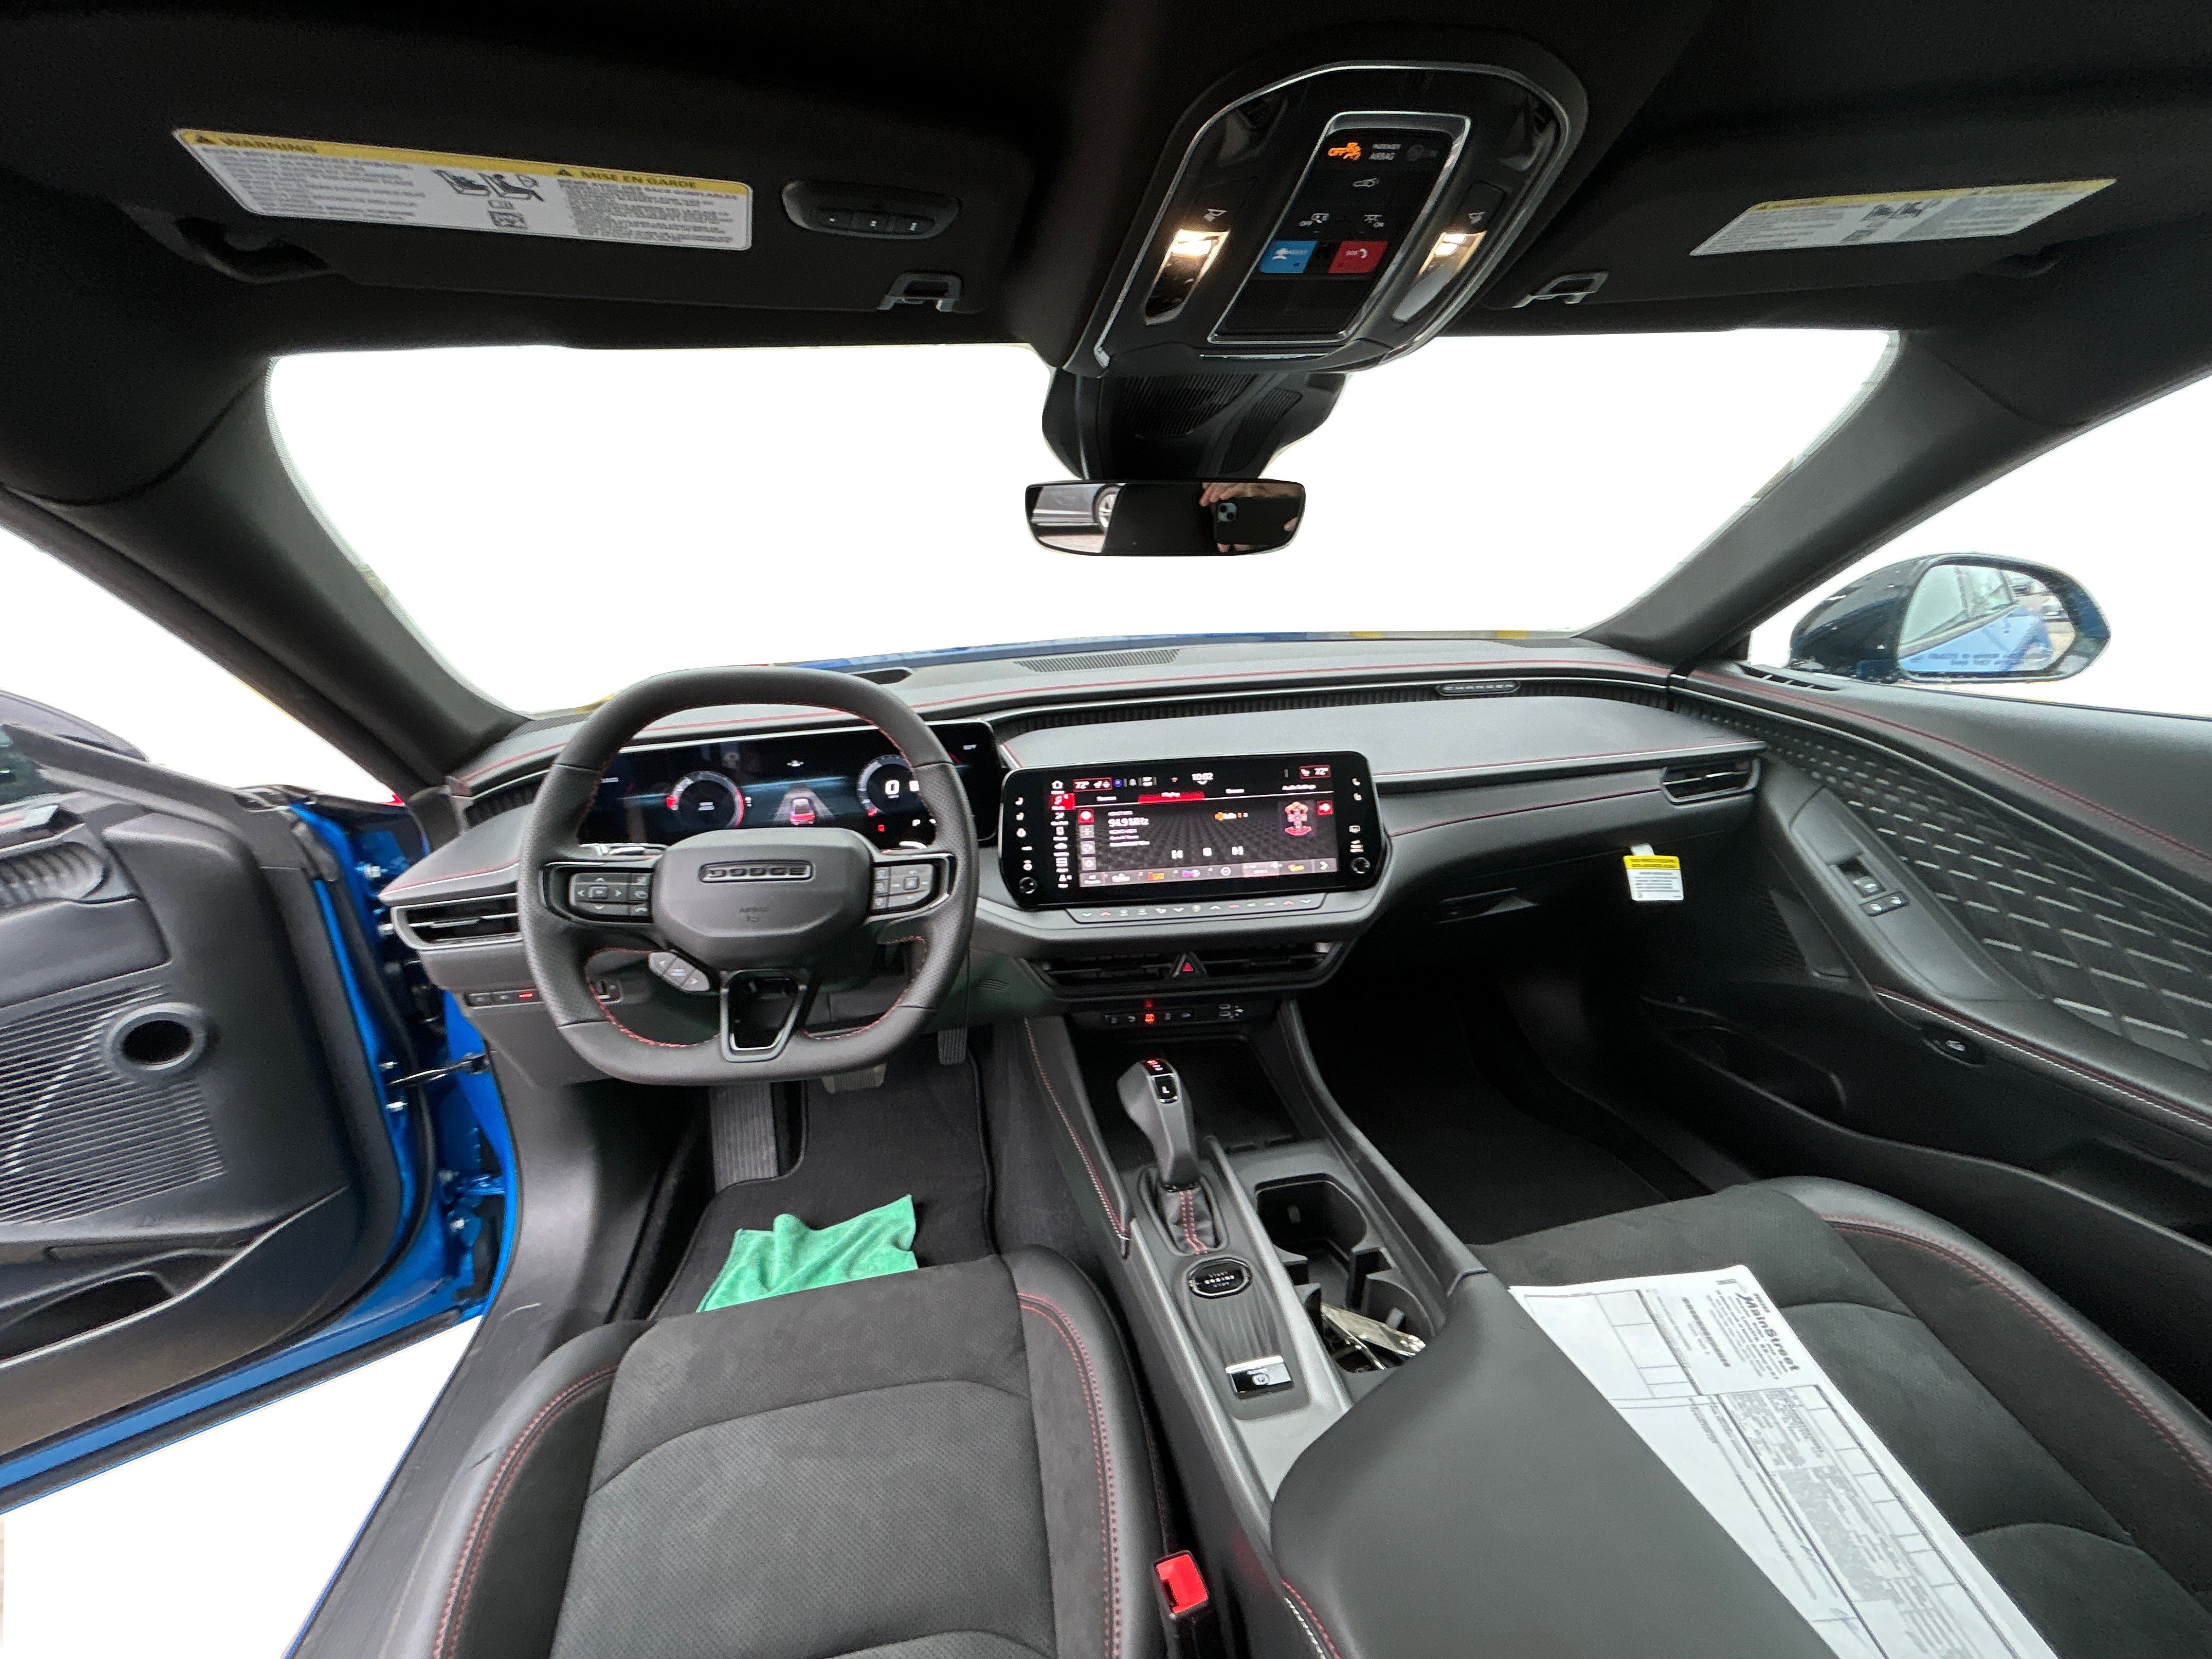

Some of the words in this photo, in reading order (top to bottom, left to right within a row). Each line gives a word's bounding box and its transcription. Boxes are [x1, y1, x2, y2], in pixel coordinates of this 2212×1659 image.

[221, 138, 318, 154] WARNING
[580, 171, 618, 181] MISE
[622, 174, 643, 184] EN
[646, 177, 696, 189] GARDE
[885, 780, 900, 795] 0
[708, 867, 806, 878] DODGE
[1735, 1293, 1801, 1371] MainStreet
